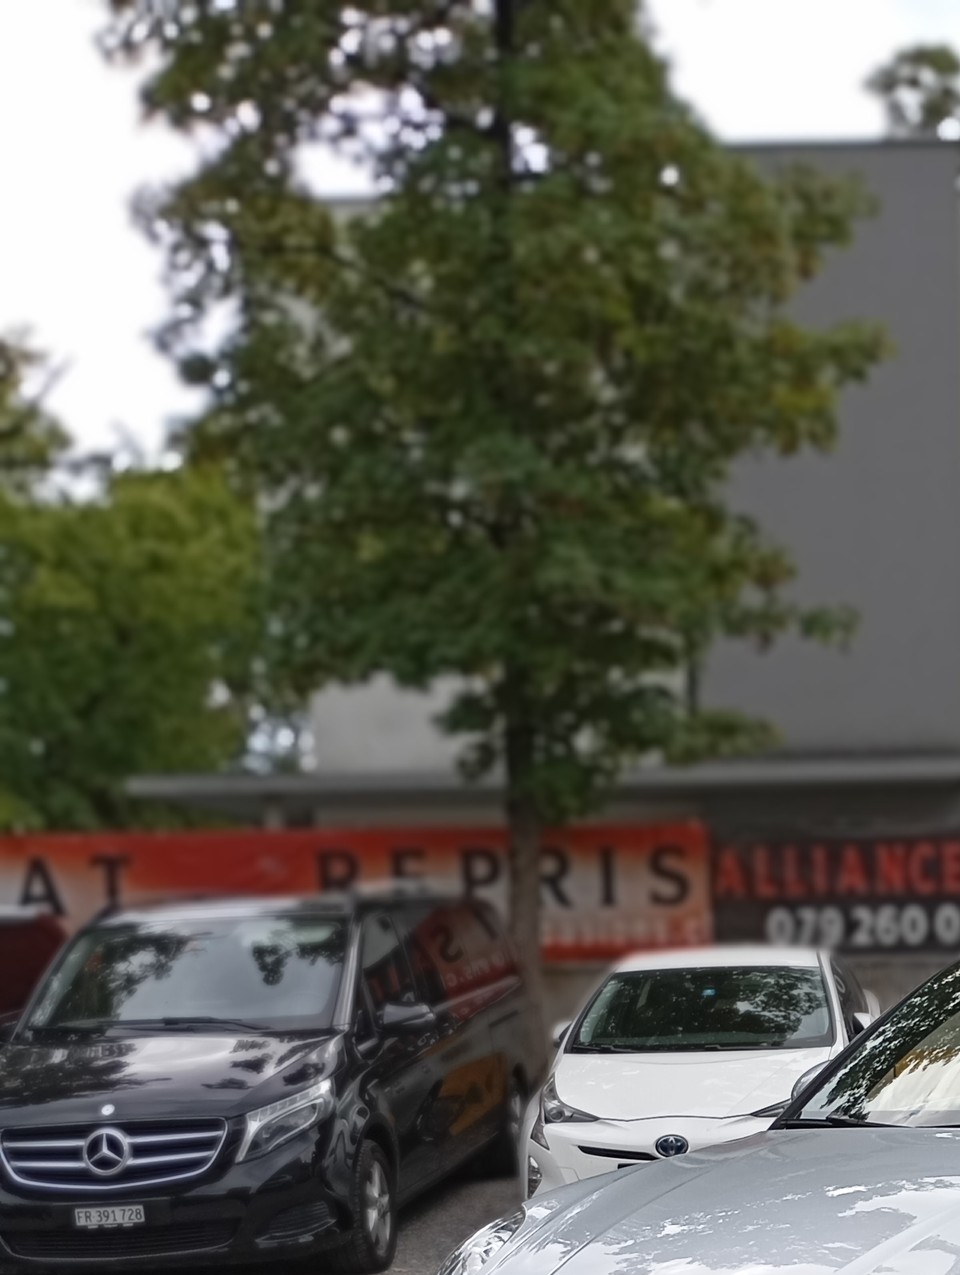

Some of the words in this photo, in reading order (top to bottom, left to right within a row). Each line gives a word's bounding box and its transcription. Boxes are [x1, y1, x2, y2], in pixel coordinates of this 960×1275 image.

[765, 902, 846, 946] 079
[850, 903, 929, 947] 260
[77, 1211, 92, 1223] FR
[95, 1209, 117, 1222] 391
[120, 1208, 142, 1221] 728
